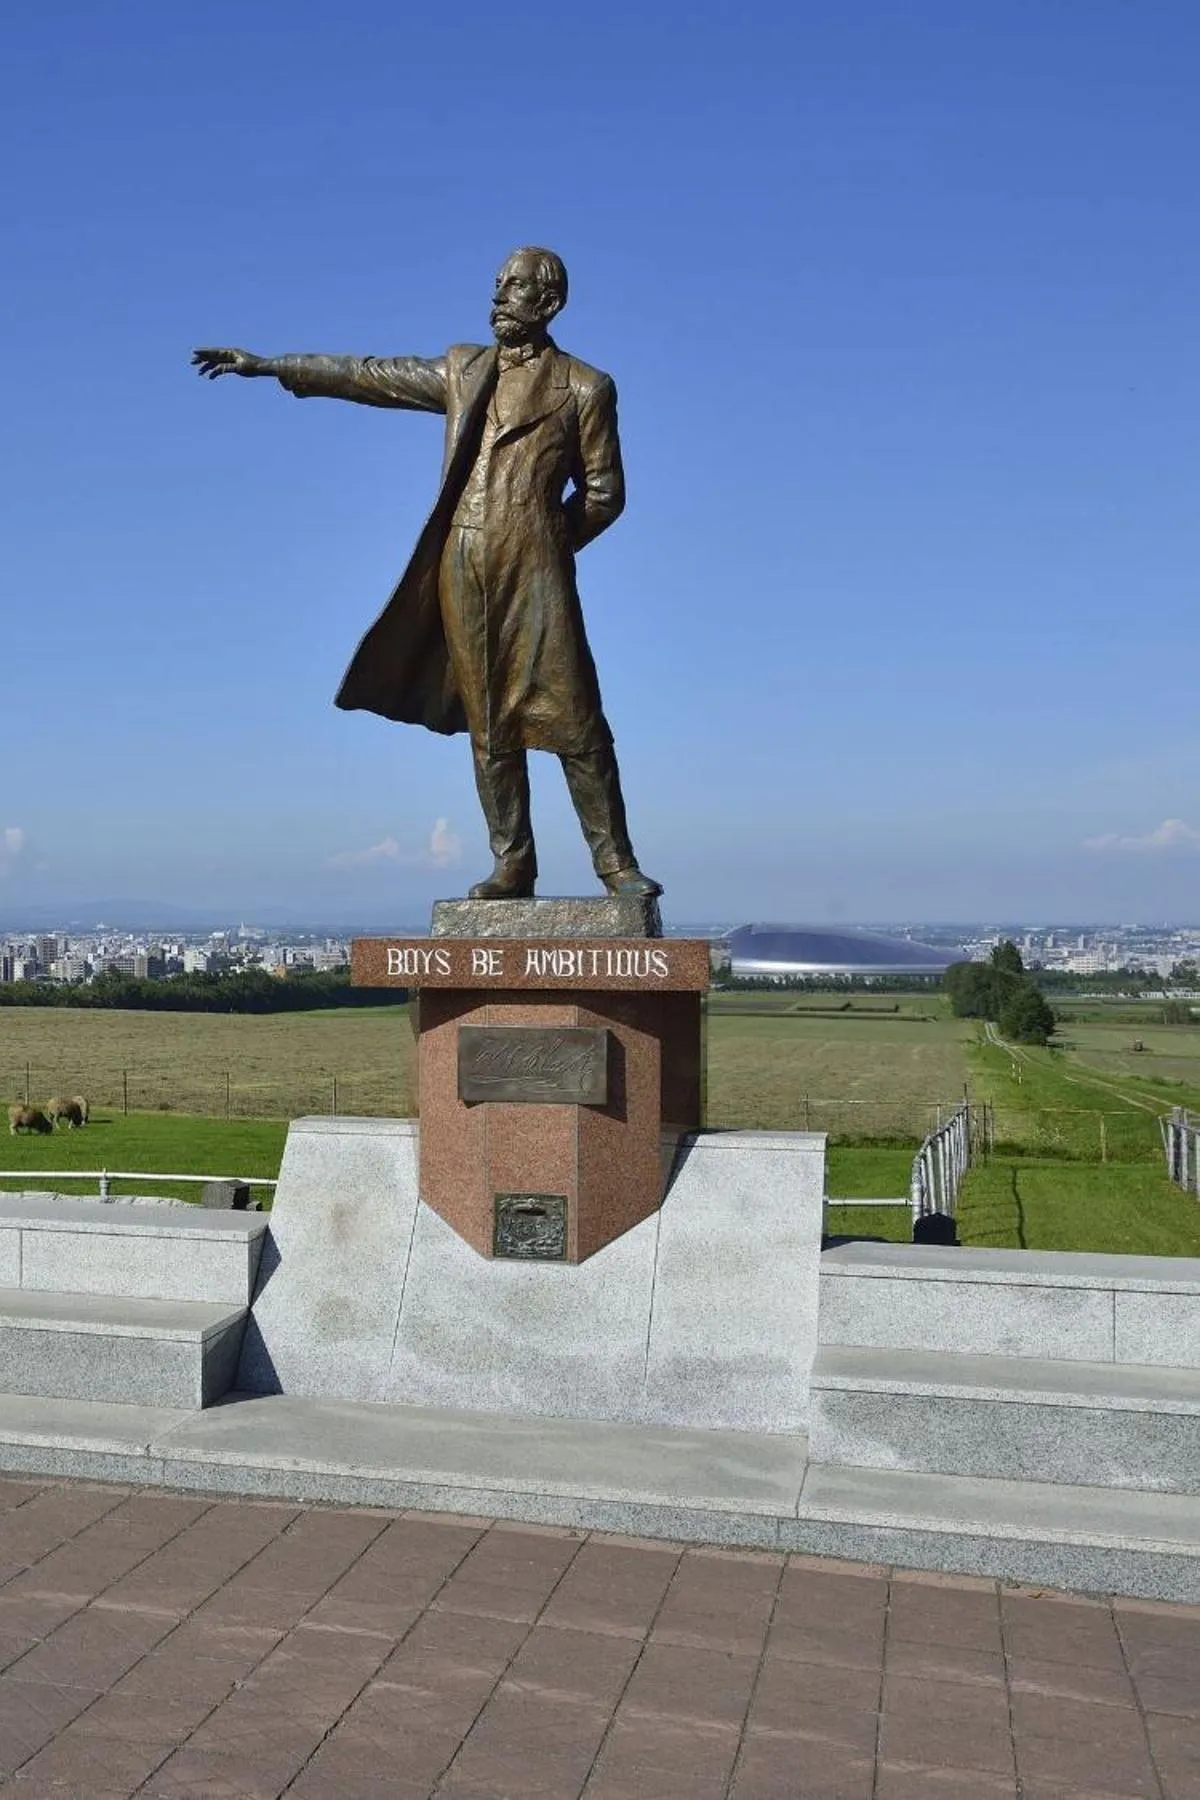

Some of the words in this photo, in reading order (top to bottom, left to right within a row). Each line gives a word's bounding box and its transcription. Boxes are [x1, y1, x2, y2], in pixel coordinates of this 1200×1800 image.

[386, 947, 452, 976] BOYS
[471, 947, 504, 977] BE
[524, 947, 669, 978] AMBITIOUS
